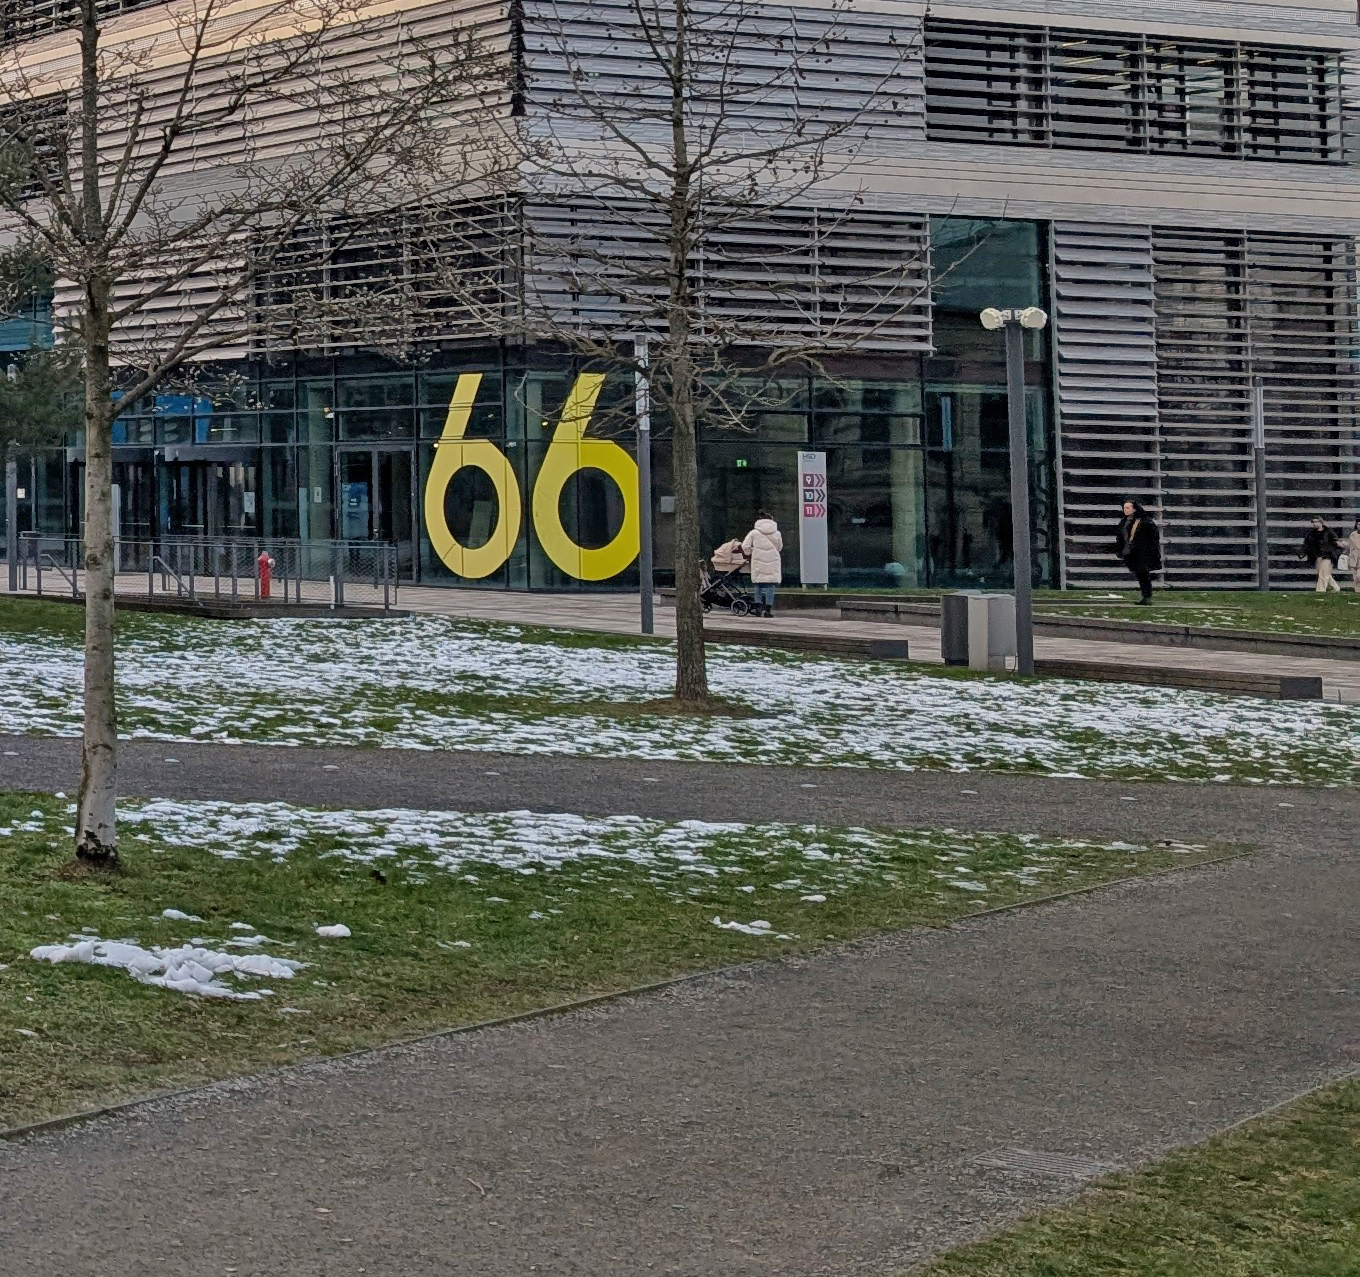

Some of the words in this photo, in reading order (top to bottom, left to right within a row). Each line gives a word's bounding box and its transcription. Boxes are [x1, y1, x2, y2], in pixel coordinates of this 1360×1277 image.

[425, 373, 641, 581] 66
[805, 476, 812, 485] 9
[805, 491, 814, 500] 10
[805, 506, 813, 514] 11
